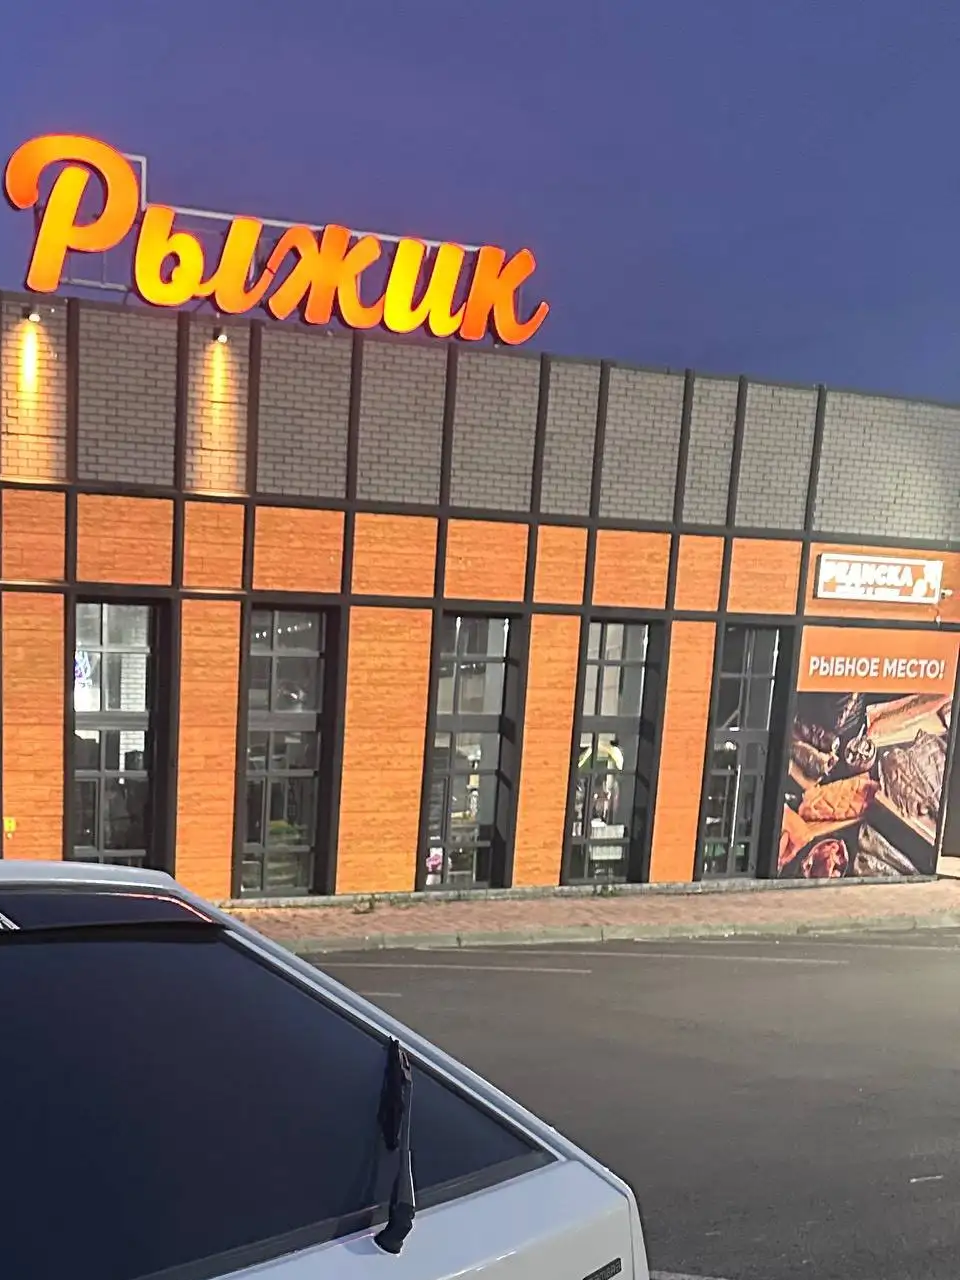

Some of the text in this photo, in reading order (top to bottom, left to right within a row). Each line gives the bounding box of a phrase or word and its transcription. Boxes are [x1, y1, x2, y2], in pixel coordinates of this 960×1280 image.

[3, 133, 550, 345] Рыжик
[808, 655, 945, 679] РЫБНОЕ МЕСТО!
